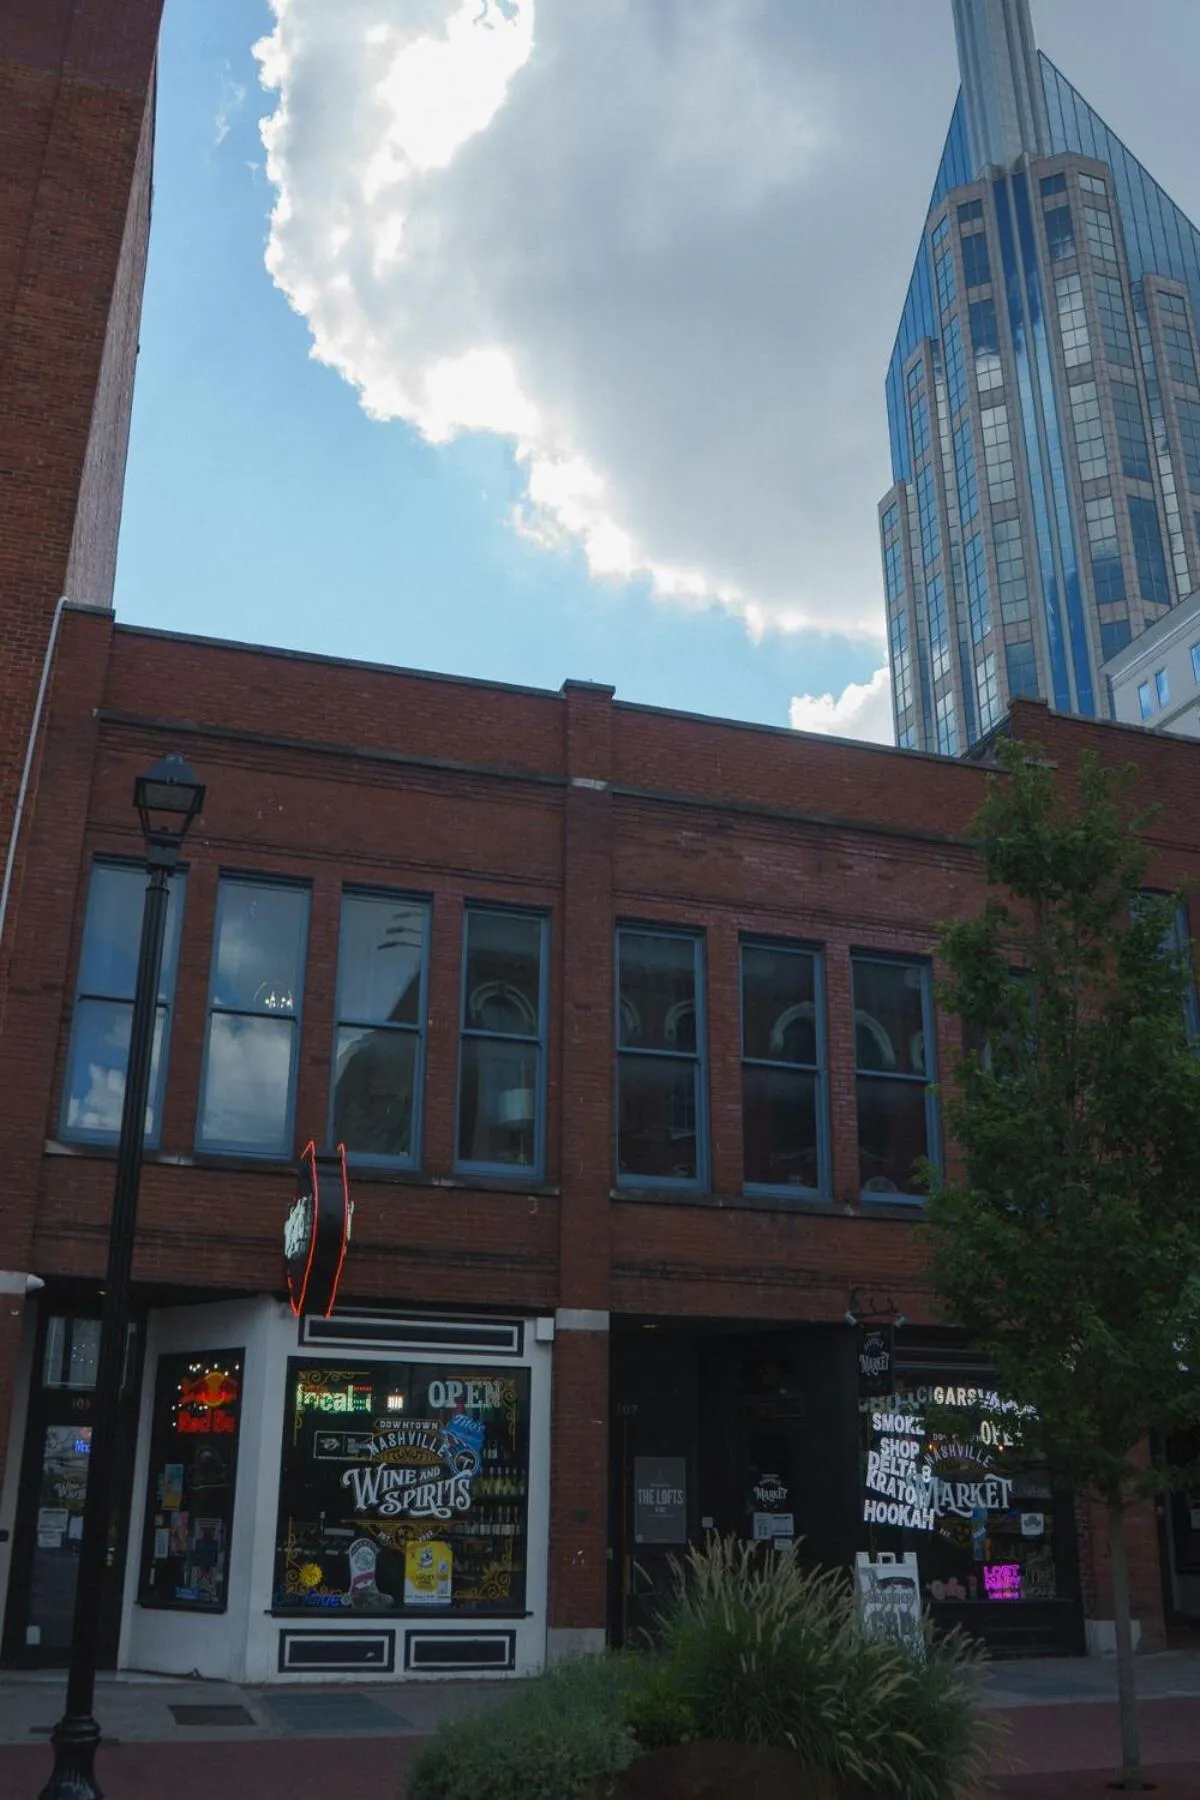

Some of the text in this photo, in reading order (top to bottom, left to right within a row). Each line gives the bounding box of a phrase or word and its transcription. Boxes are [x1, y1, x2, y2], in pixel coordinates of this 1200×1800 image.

[428, 1380, 502, 1409] OPEN
[379, 1420, 439, 1430] DOWNTOWN
[872, 1412, 926, 1436] SMOKE
[368, 1431, 447, 1456] NASHVILLE
[880, 1437, 920, 1459] SHOP
[923, 1443, 994, 1469] NASHVILLE
[867, 1450, 932, 1483] DELTA 8
[342, 1463, 441, 1511] WINE AND
[379, 1469, 473, 1520] SPIRITS
[637, 1488, 685, 1506] THE LOFTS
[906, 1473, 1014, 1519] MARKET
[863, 1499, 935, 1531] HOOKAH
